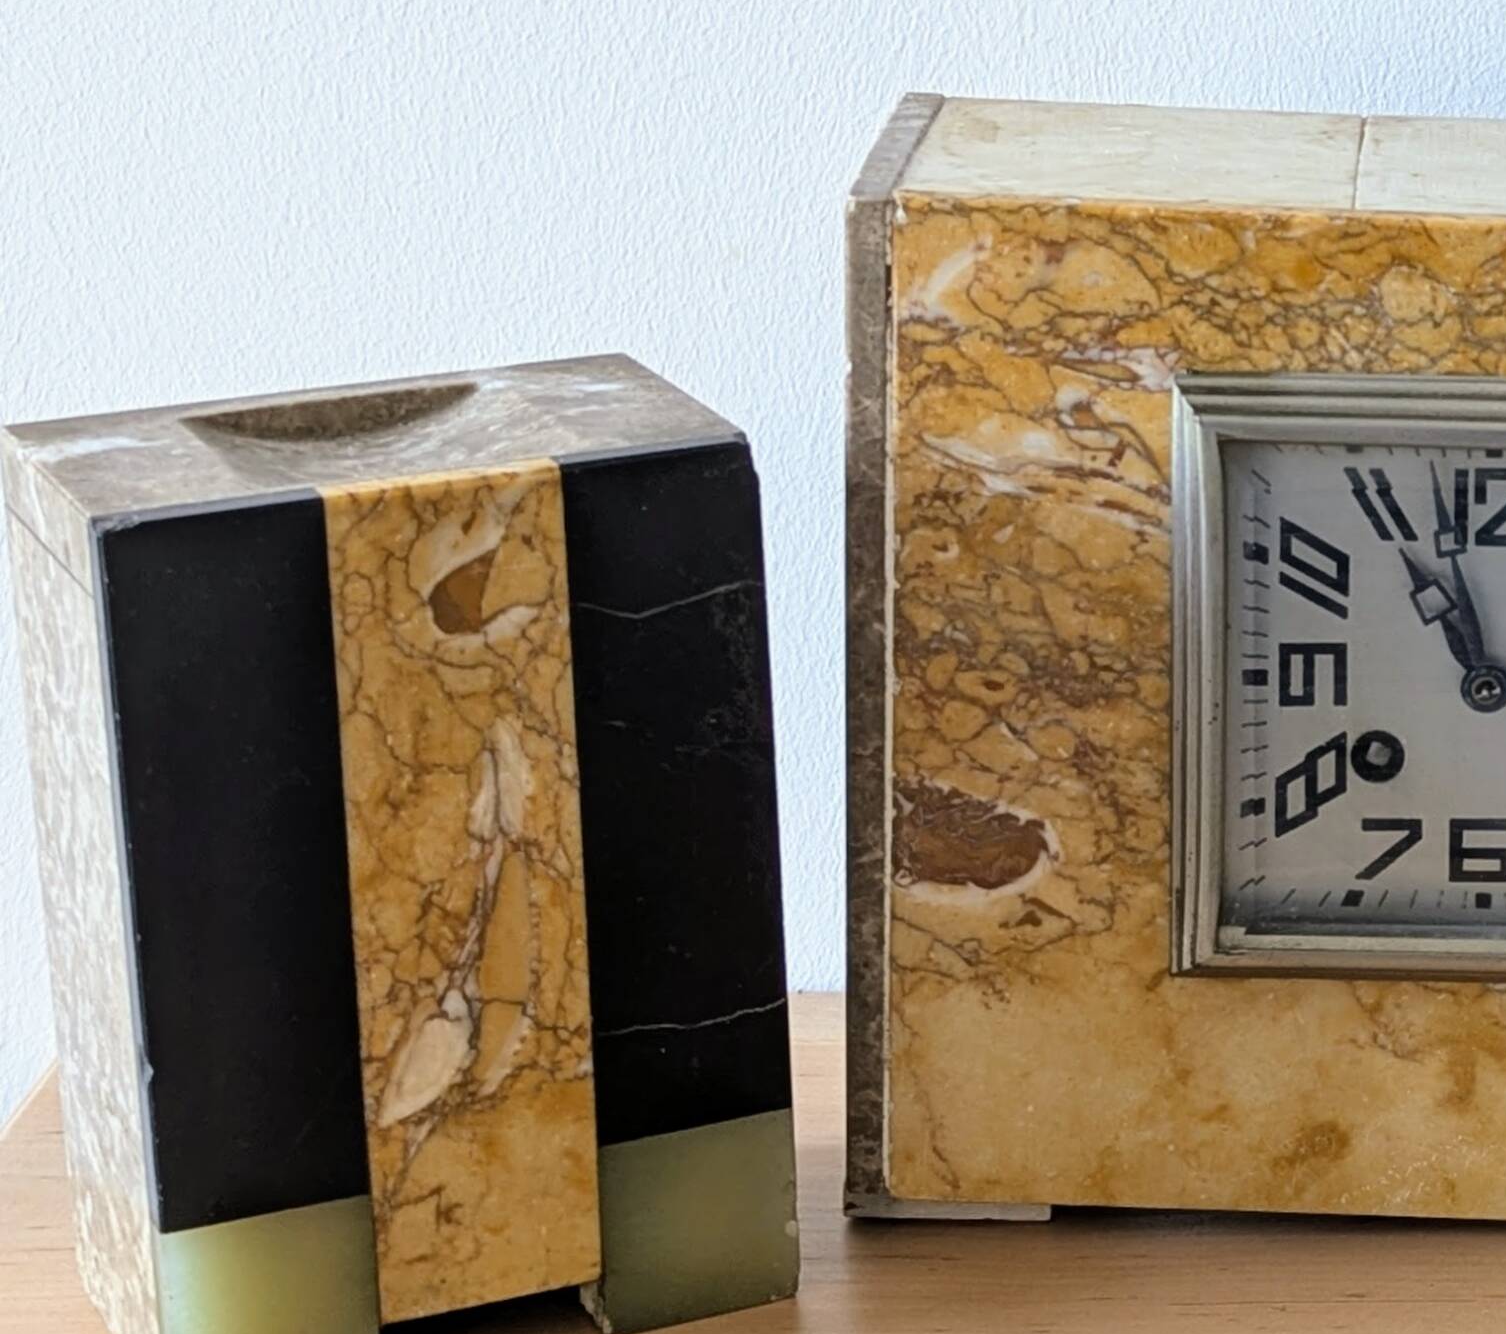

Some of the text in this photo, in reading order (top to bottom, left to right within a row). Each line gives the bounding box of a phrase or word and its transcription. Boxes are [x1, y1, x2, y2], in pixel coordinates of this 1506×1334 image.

[1278, 516, 1350, 620] 10
[1278, 642, 1348, 707] 9
[1274, 731, 1348, 838] 8
[1355, 818, 1423, 880] 7
